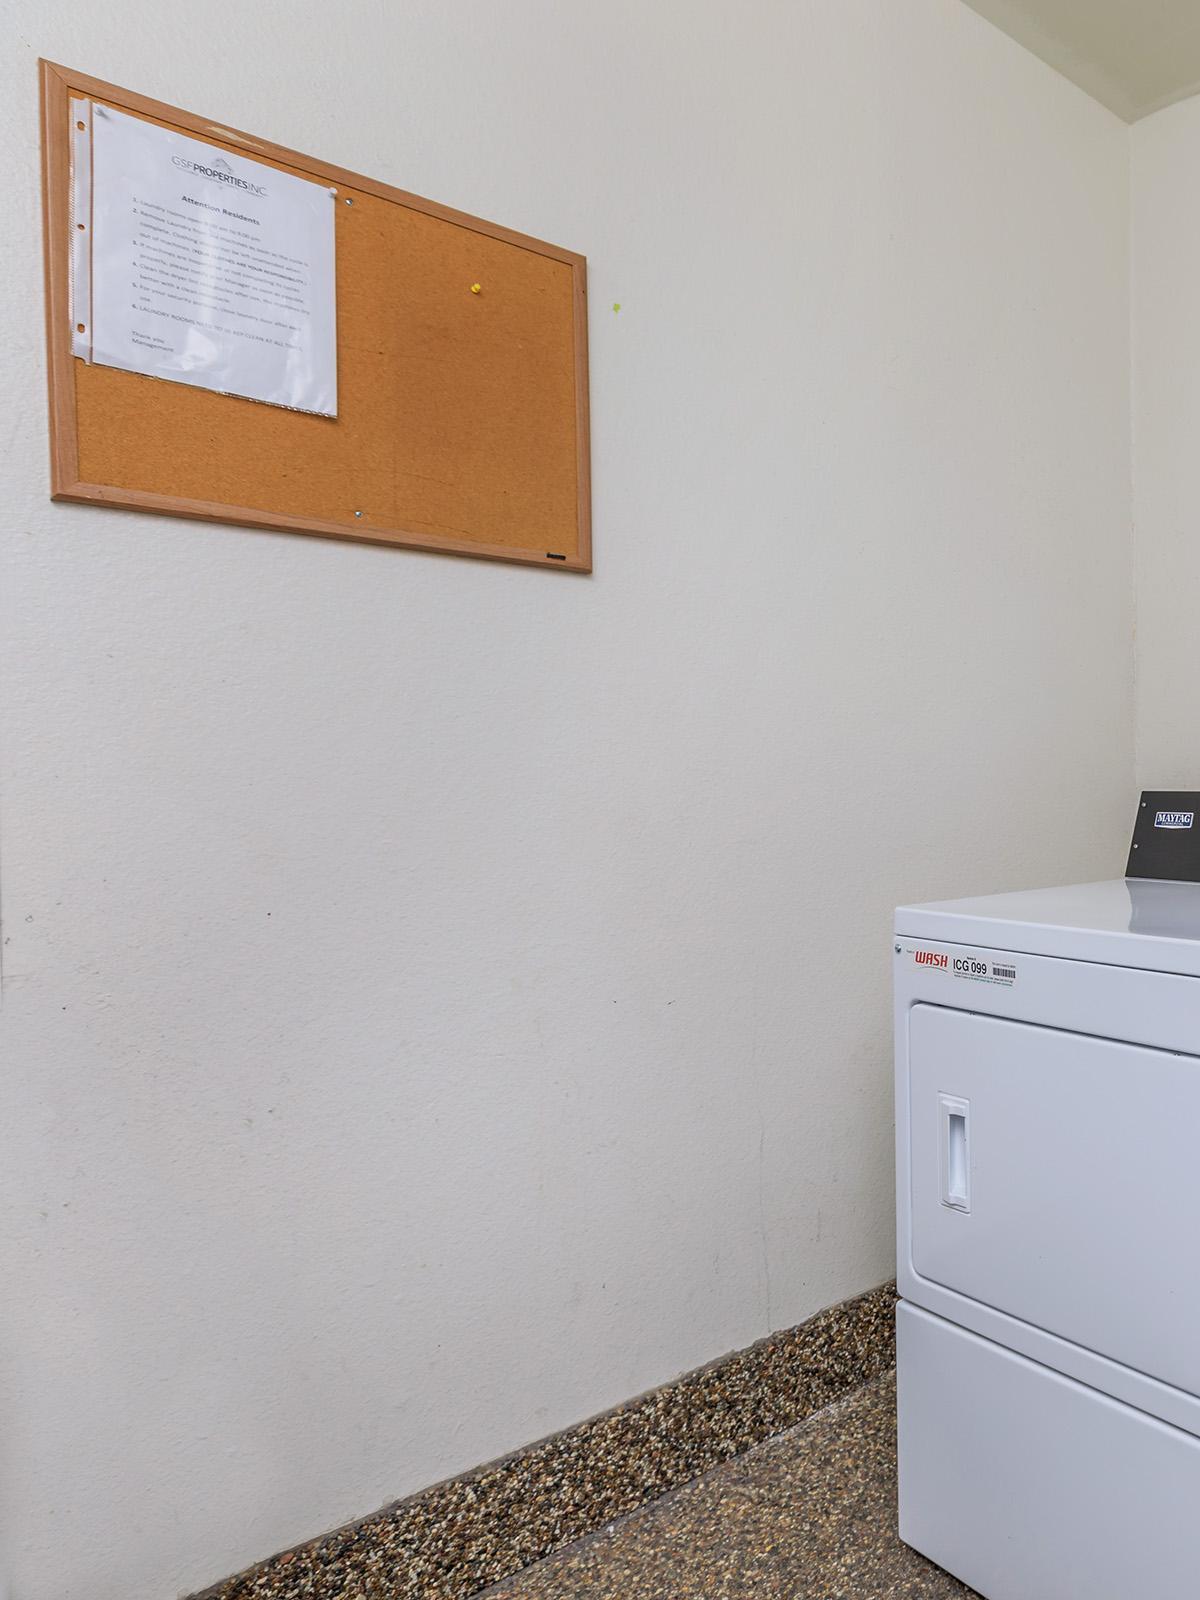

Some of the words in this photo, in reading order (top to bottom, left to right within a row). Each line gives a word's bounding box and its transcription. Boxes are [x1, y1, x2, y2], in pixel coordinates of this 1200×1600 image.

[182, 195, 221, 213] Attention
[223, 208, 260, 226] Residents
[1157, 813, 1191, 823] MAYTAG
[915, 951, 948, 967] WASH
[953, 958, 969, 972] ICG
[971, 961, 987, 975] 099
